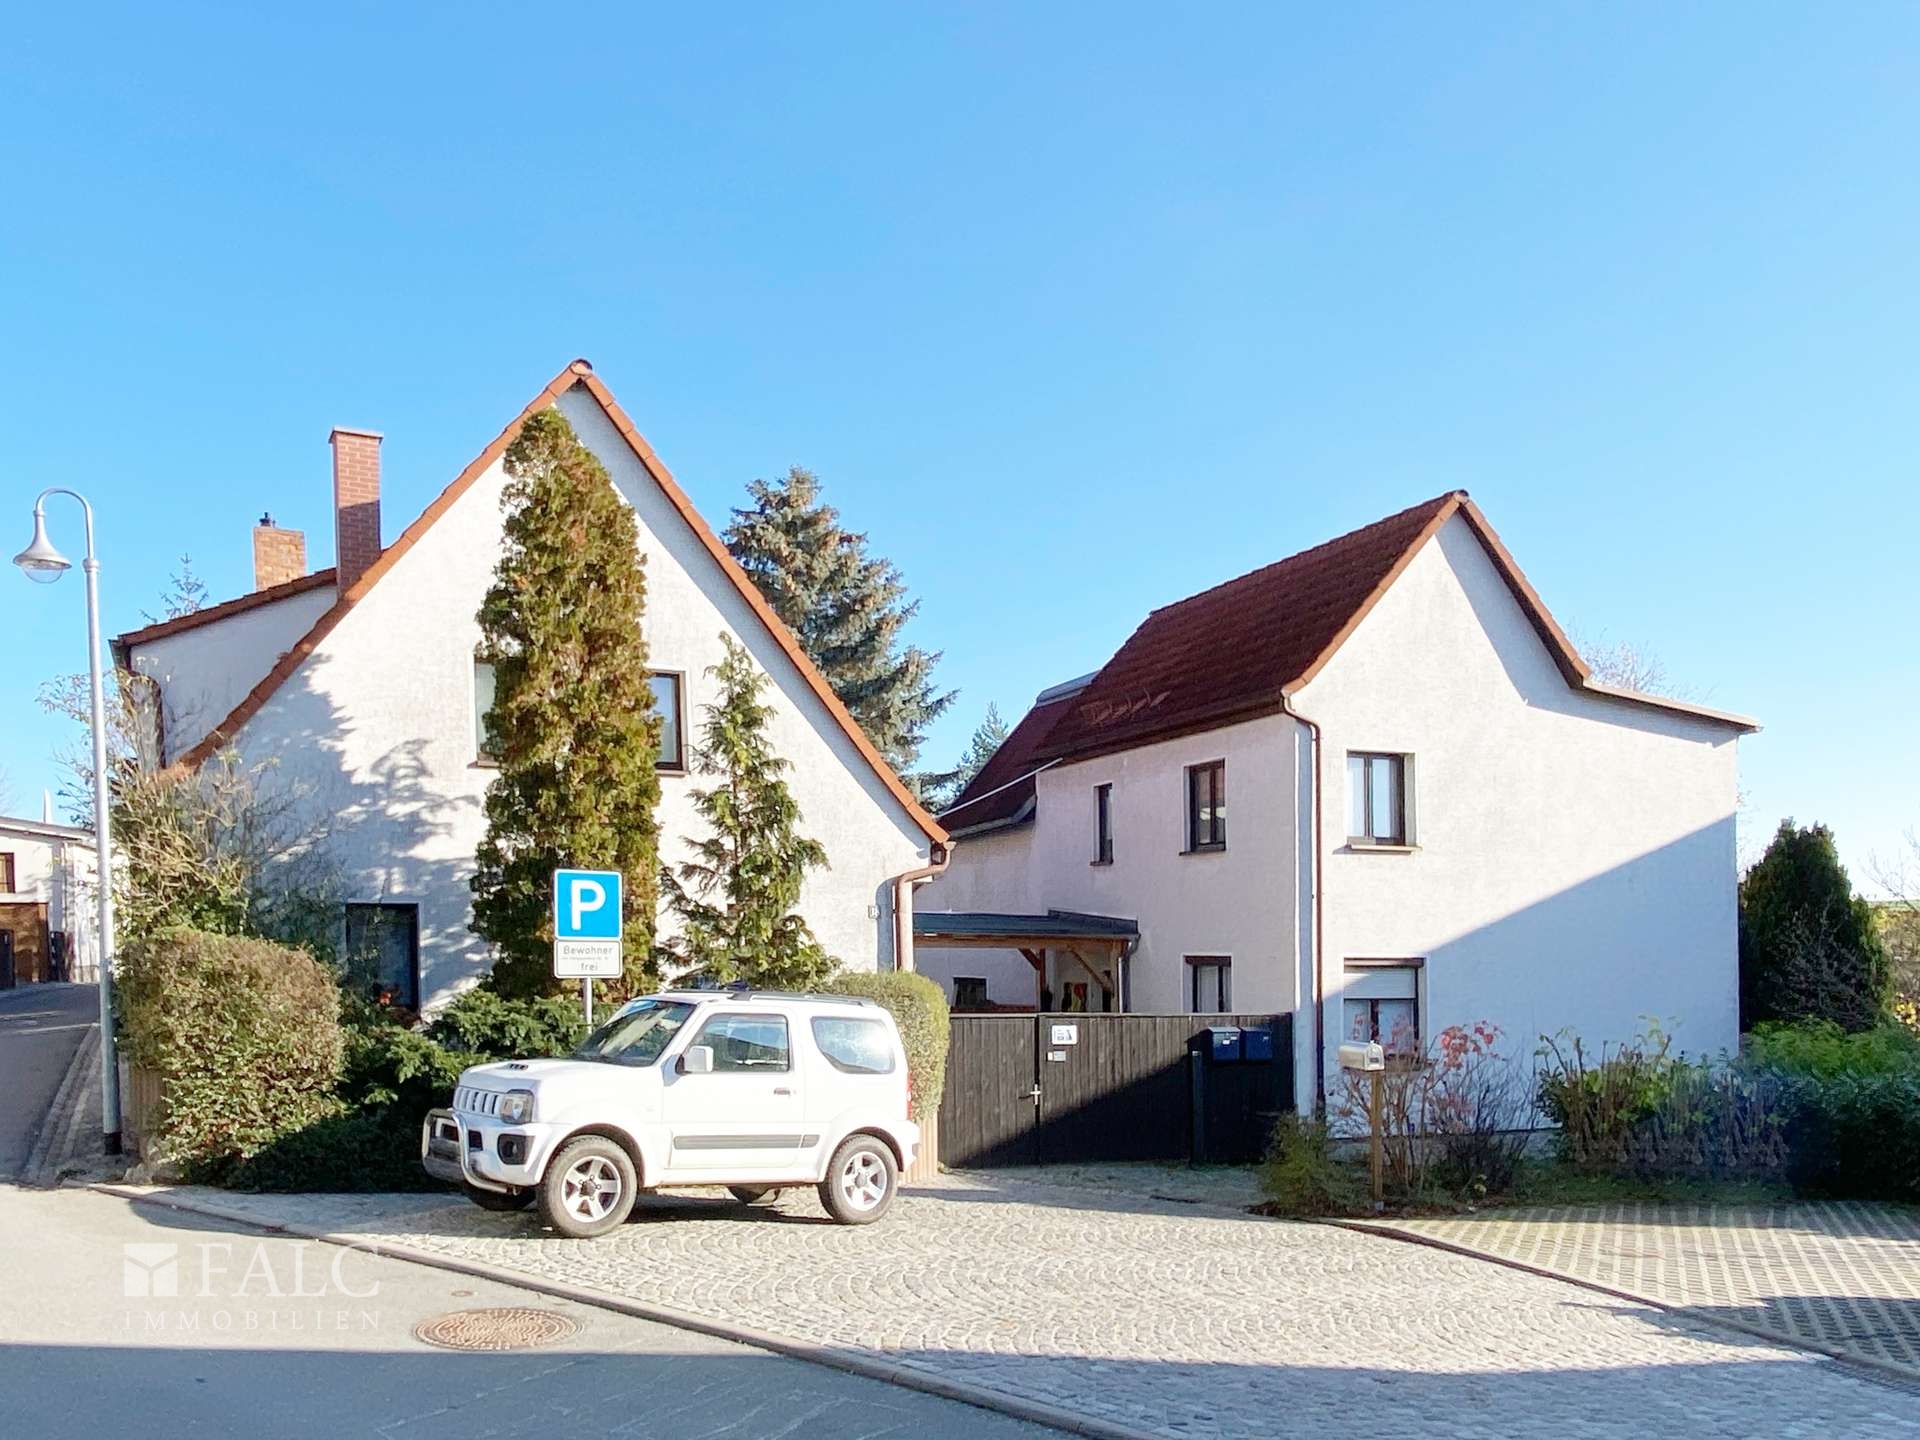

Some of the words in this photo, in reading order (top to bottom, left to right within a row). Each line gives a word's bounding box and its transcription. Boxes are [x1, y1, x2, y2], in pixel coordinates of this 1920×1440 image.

[571, 879, 606, 930] P
[563, 945, 613, 955] Bewohner
[580, 962, 598, 971] frei
